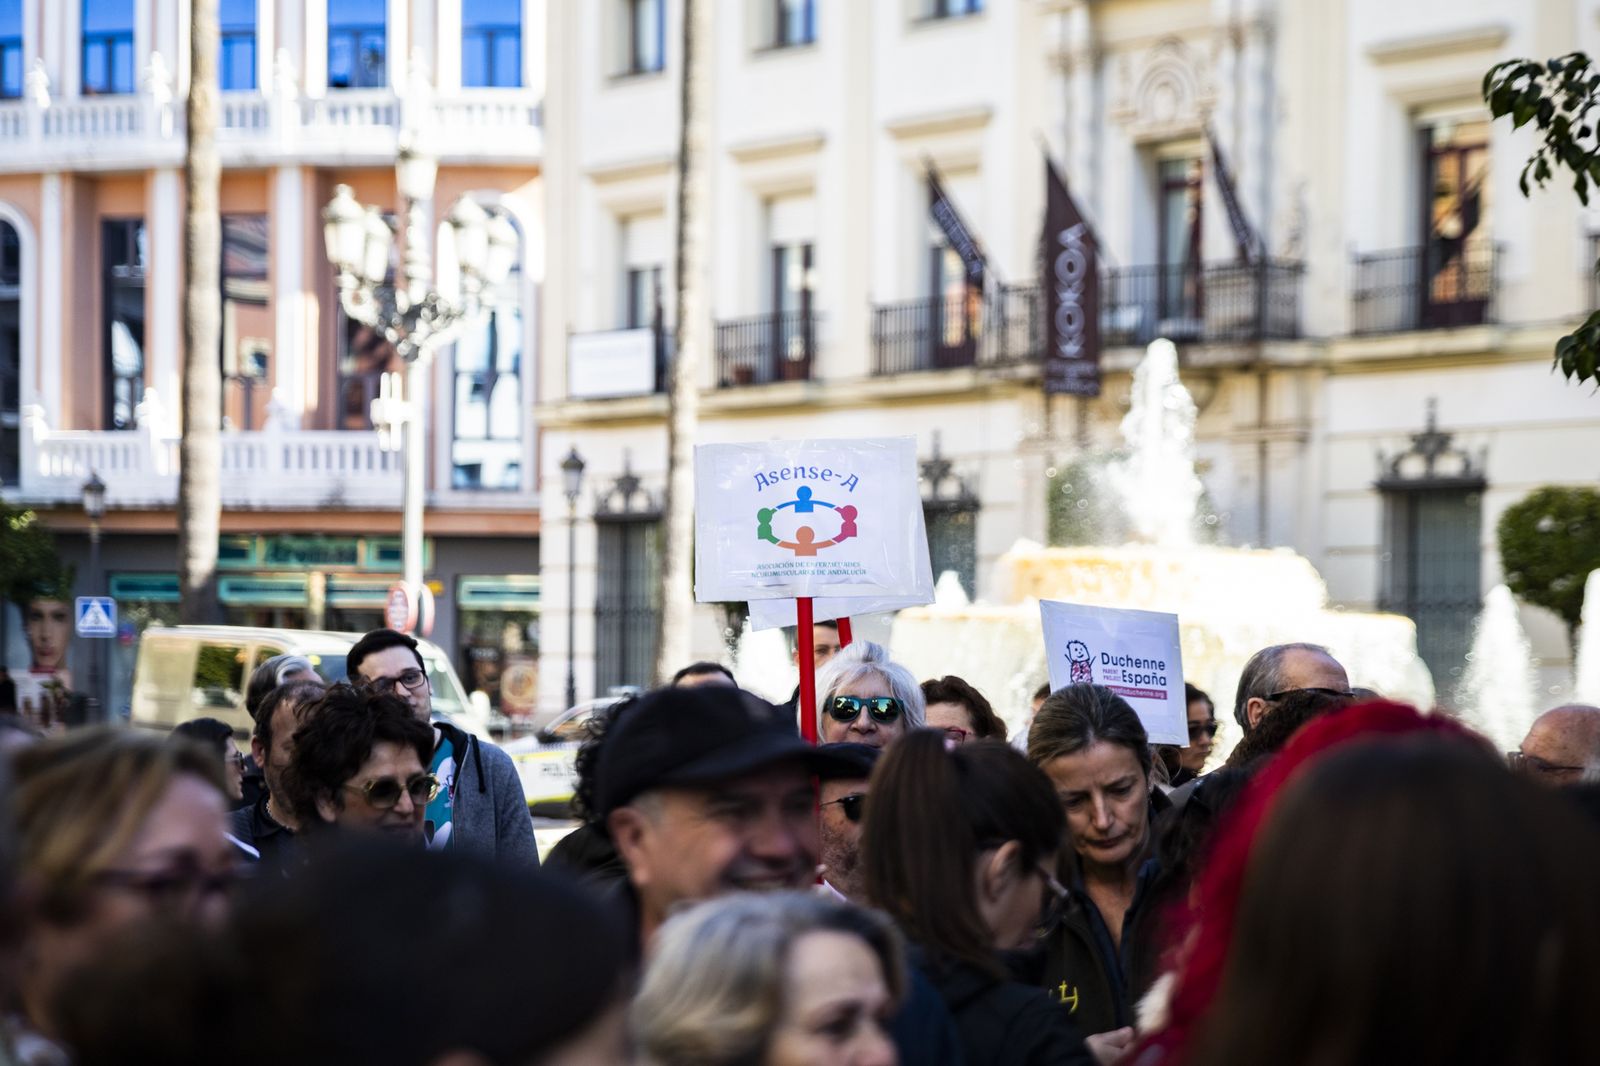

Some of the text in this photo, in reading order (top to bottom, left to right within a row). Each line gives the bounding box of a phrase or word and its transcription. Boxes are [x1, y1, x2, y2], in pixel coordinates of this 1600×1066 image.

[754, 466, 859, 492] Asense-A
[757, 560, 794, 570] ASOCIACIÓN
[827, 568, 866, 576] ANDALUCÍA
[1101, 652, 1165, 671] Duchenne
[1122, 670, 1167, 686] España
